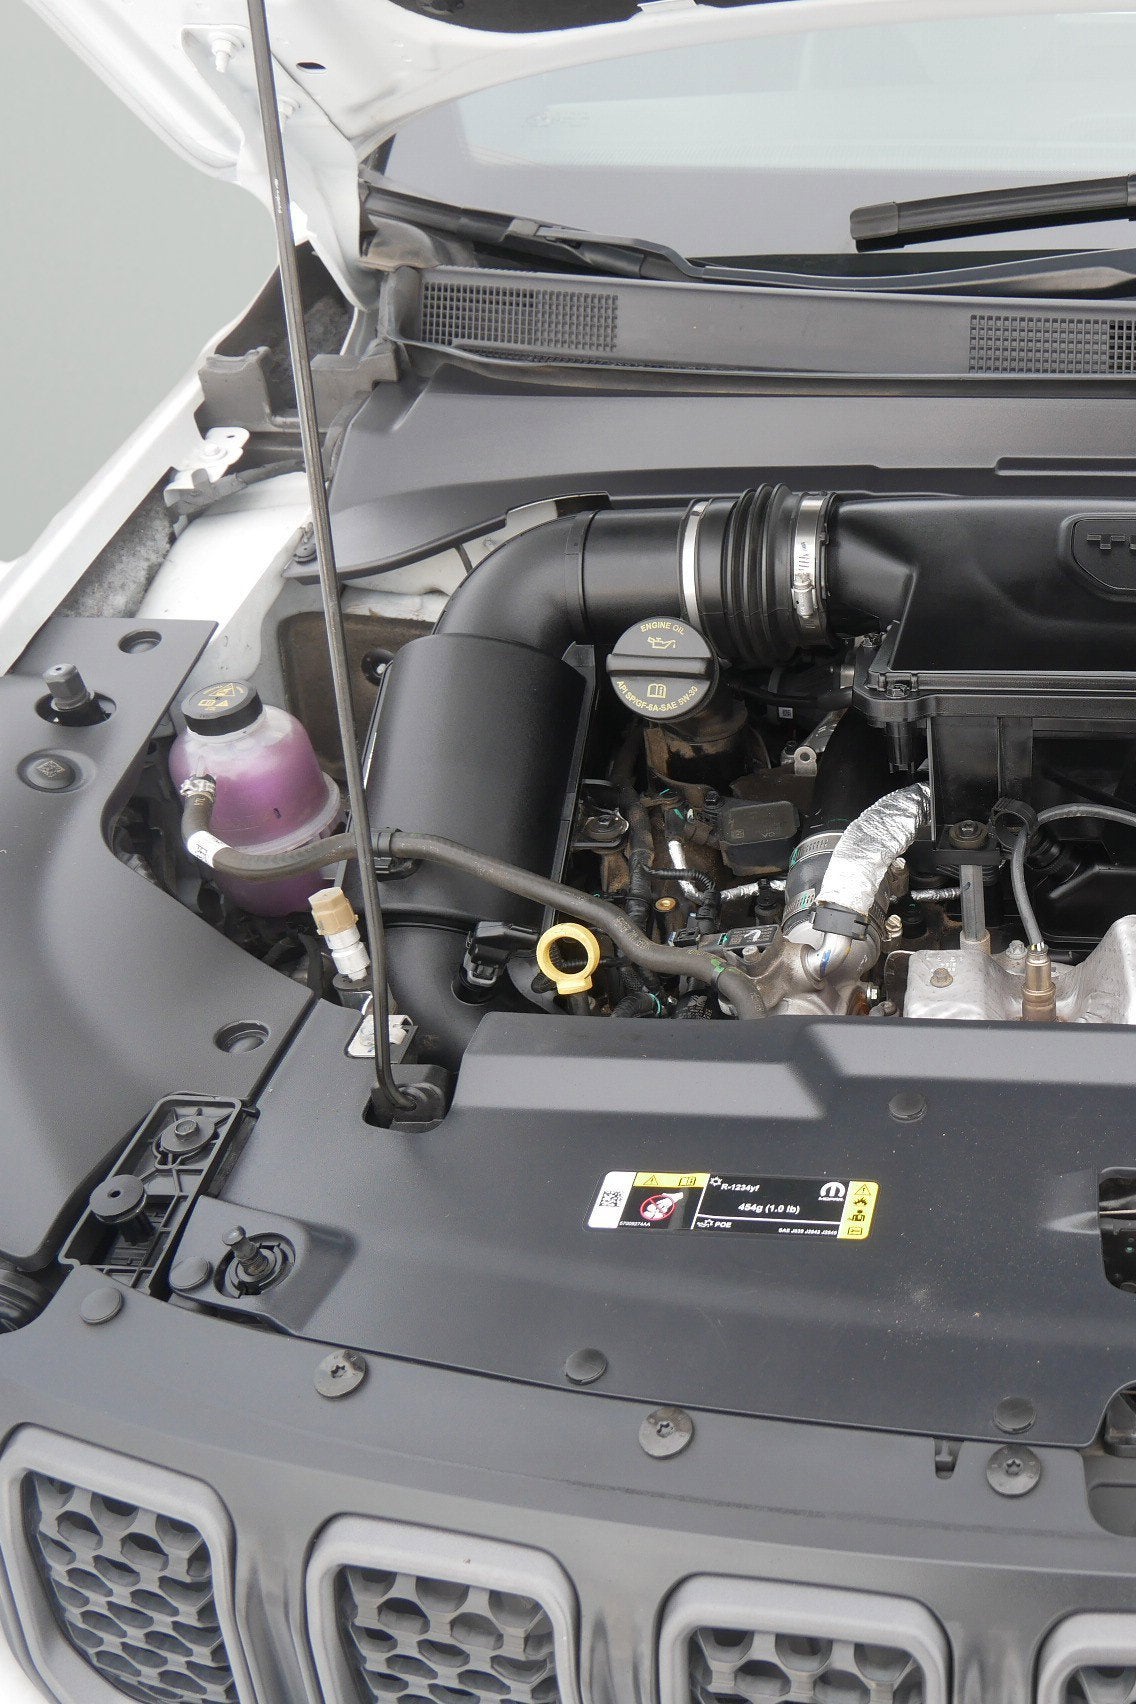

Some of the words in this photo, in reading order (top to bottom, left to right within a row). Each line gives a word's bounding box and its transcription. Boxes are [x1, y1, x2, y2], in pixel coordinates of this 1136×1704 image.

[640, 621, 671, 632] ENGINE
[673, 624, 686, 635] OIL
[616, 680, 628, 694] API
[679, 685, 698, 705] 5W-30
[720, 1183, 760, 1193] R-1234yf
[738, 1202, 763, 1214] 454g
[765, 1204, 785, 1214] (1.0
[786, 1204, 800, 1215] lb)
[714, 1221, 732, 1229] POE
